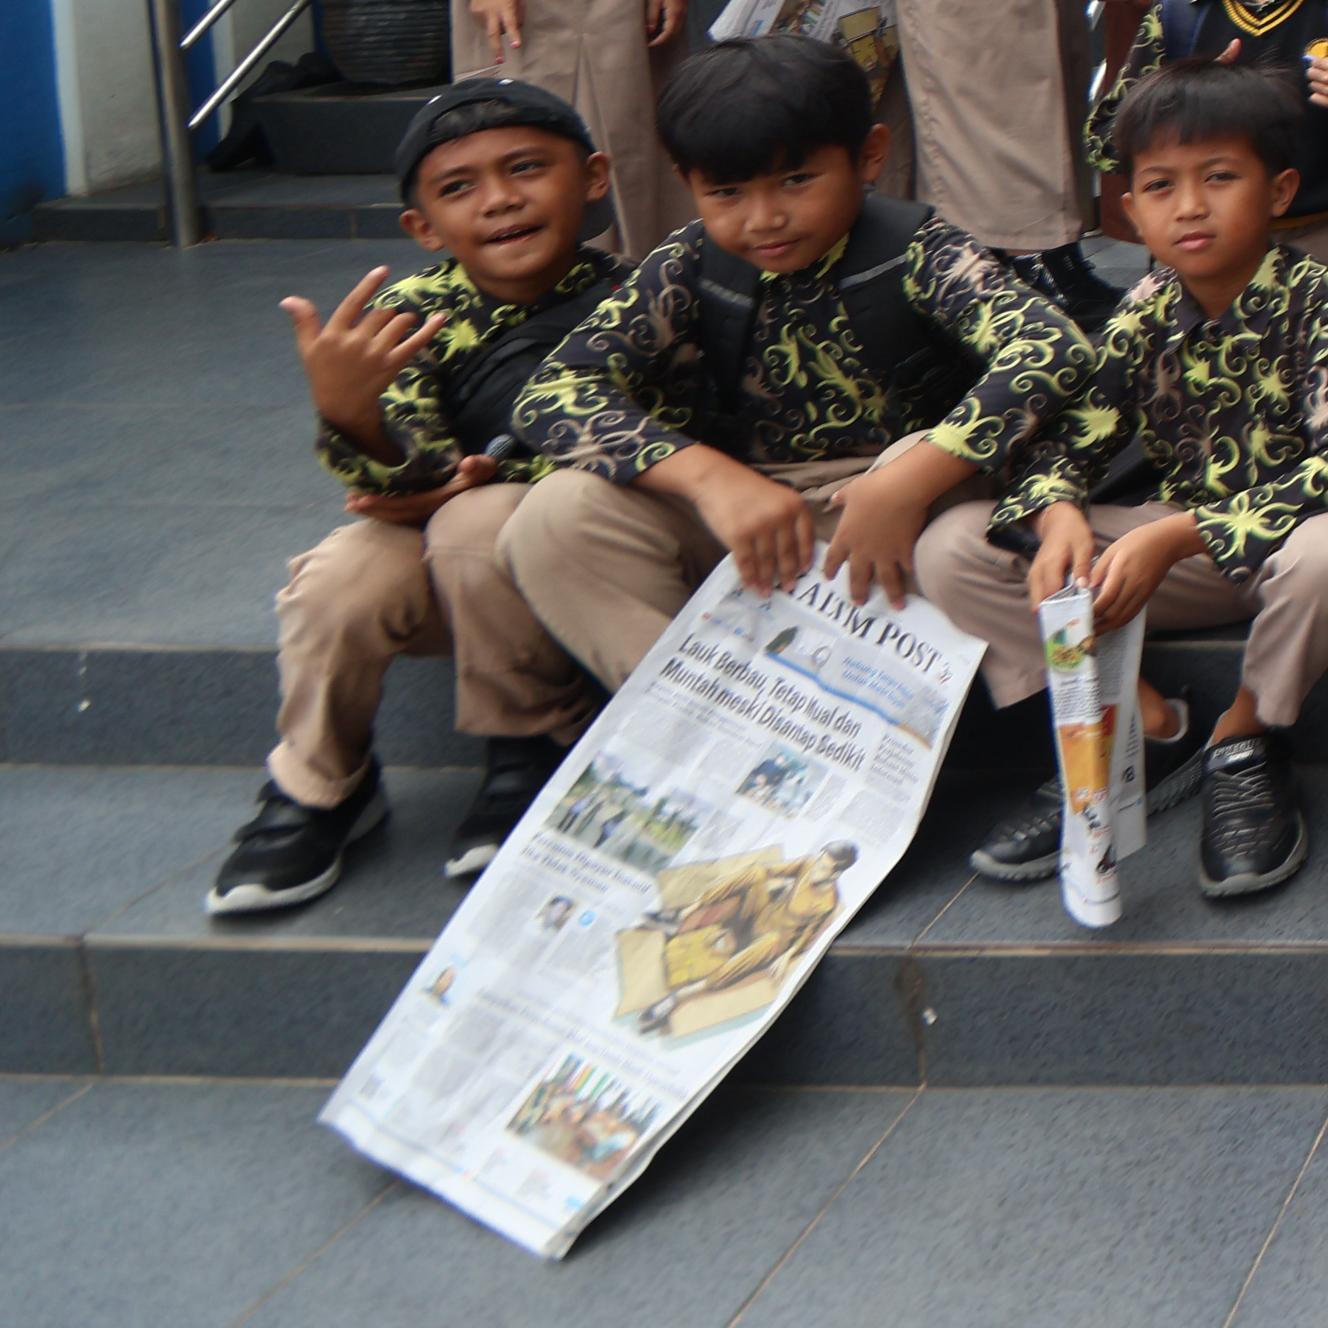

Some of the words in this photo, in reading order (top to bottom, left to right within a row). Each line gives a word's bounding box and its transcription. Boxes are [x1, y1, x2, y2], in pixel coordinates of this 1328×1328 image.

[678, 632, 720, 667] Lauk
[768, 677, 807, 713] Tetap
[833, 711, 862, 739] dan
[876, 619, 946, 673] POST
[659, 657, 721, 701] Muntah
[714, 684, 768, 721] meski
[758, 705, 818, 753] Disantap
[816, 734, 866, 772] Sedikit
